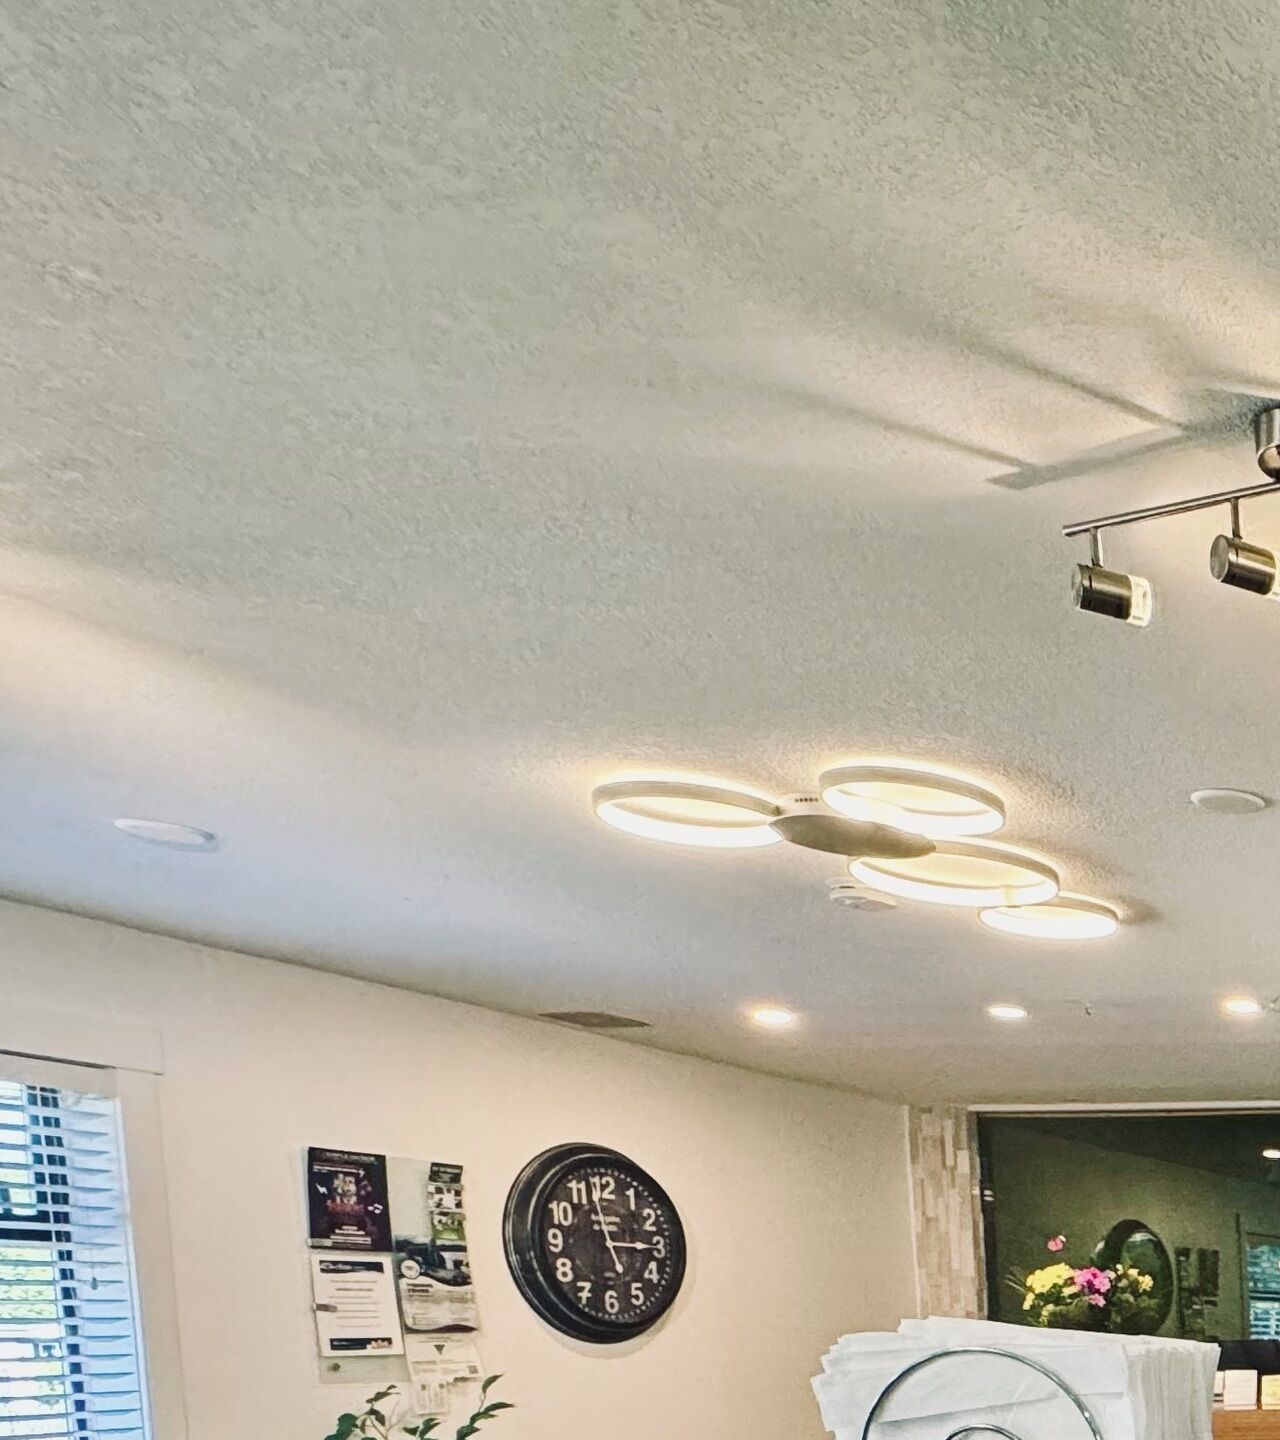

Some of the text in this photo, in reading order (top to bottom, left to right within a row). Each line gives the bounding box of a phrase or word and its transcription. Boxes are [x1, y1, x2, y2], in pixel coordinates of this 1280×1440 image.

[568, 1180, 587, 1204] 11
[626, 1188, 635, 1210] 1
[549, 1201, 573, 1226] 10
[643, 1209, 657, 1231] 2
[548, 1229, 563, 1252] 9
[652, 1236, 665, 1258] 3
[556, 1258, 573, 1282] 8
[644, 1261, 659, 1283] 4
[577, 1282, 592, 1304] 7
[605, 1291, 619, 1313] 6
[631, 1283, 644, 1305] 5
